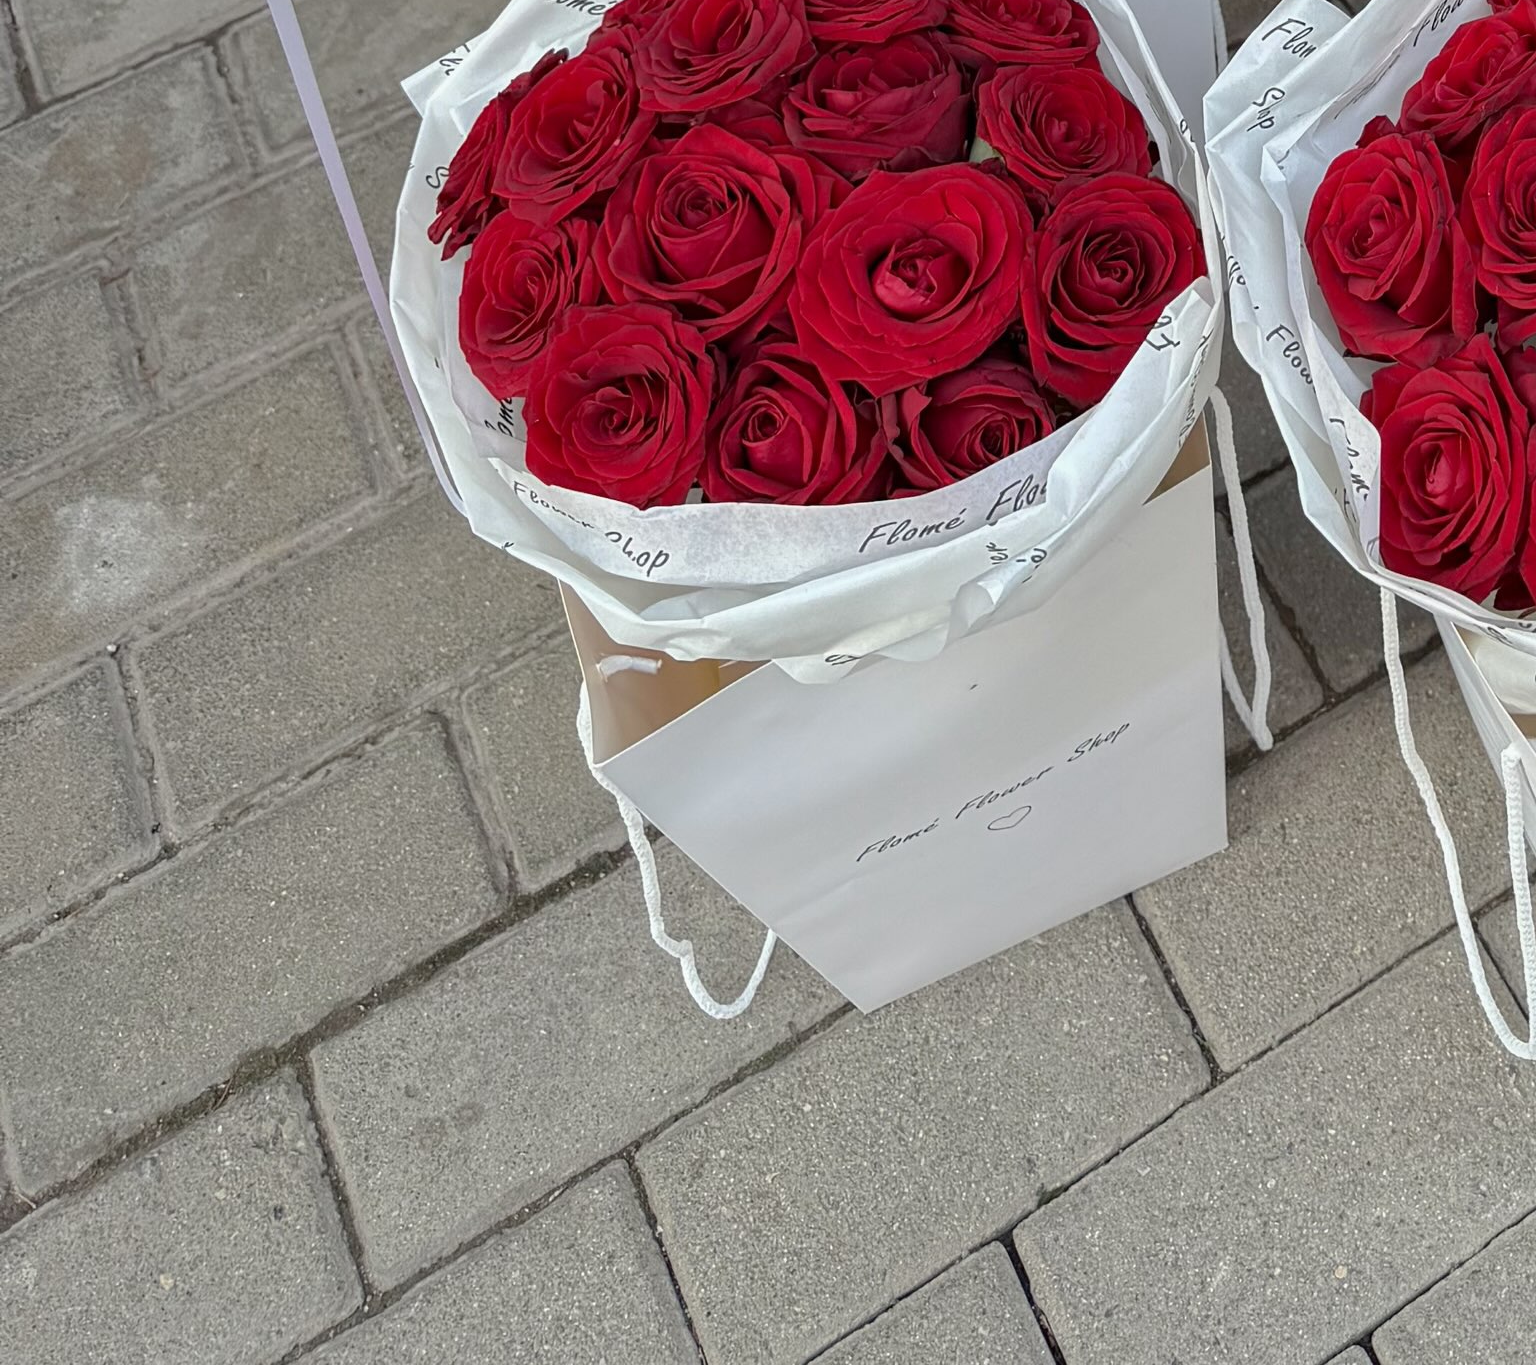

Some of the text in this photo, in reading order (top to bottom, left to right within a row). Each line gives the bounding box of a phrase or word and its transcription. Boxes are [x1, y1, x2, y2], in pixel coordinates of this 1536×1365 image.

[858, 507, 968, 554] Flomé
[856, 722, 1131, 862] Flomé Flower Shop
